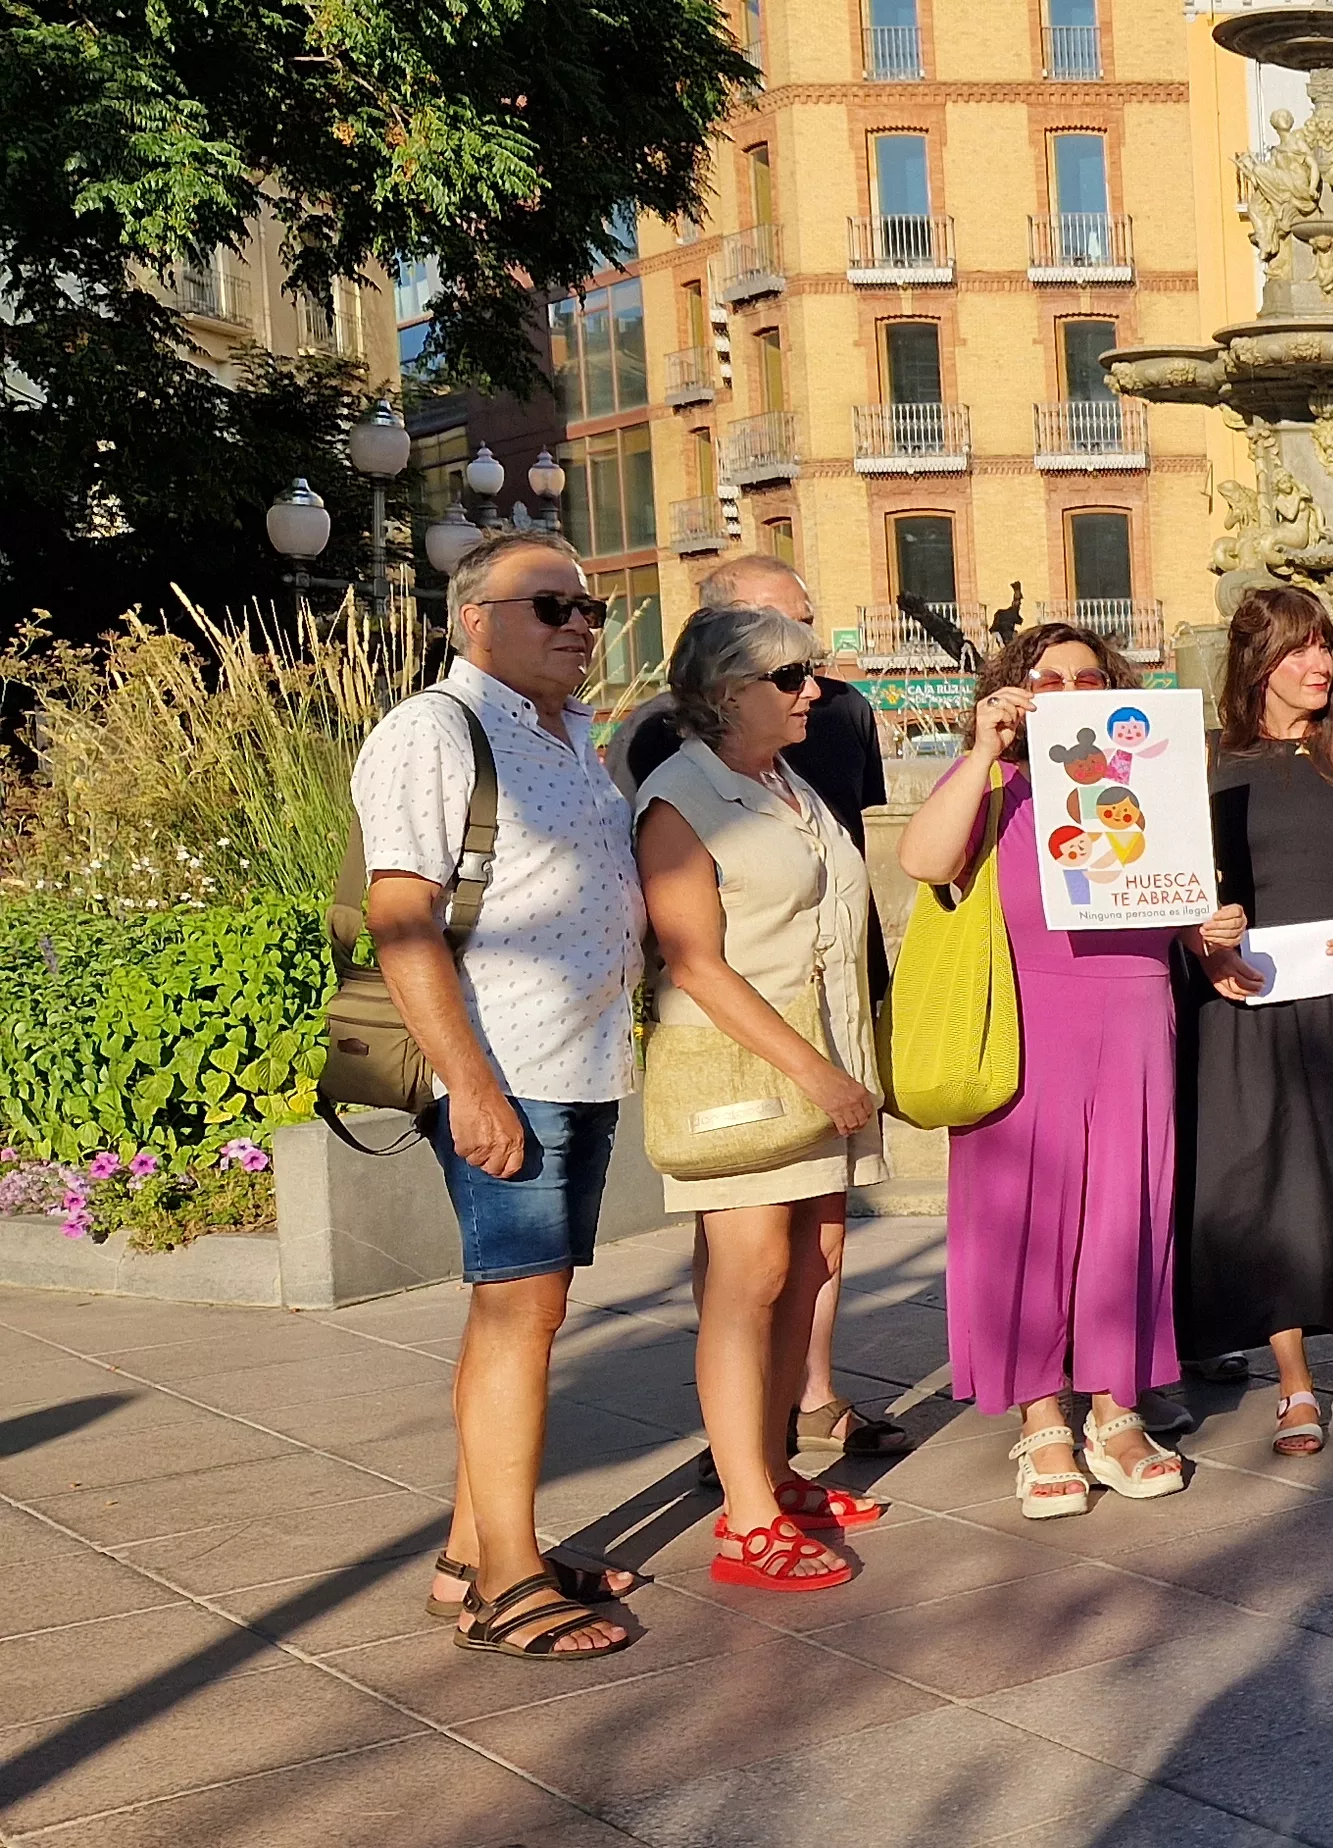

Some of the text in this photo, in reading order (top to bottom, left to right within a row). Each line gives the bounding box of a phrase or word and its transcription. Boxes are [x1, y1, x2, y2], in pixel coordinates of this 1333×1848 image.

[907, 683, 973, 695] CAJA RURAL
[1125, 872, 1201, 890] HUESCA
[1111, 889, 1209, 907] TE ABRAZA
[1079, 905, 1210, 922] Ninguna persona es ilegal
